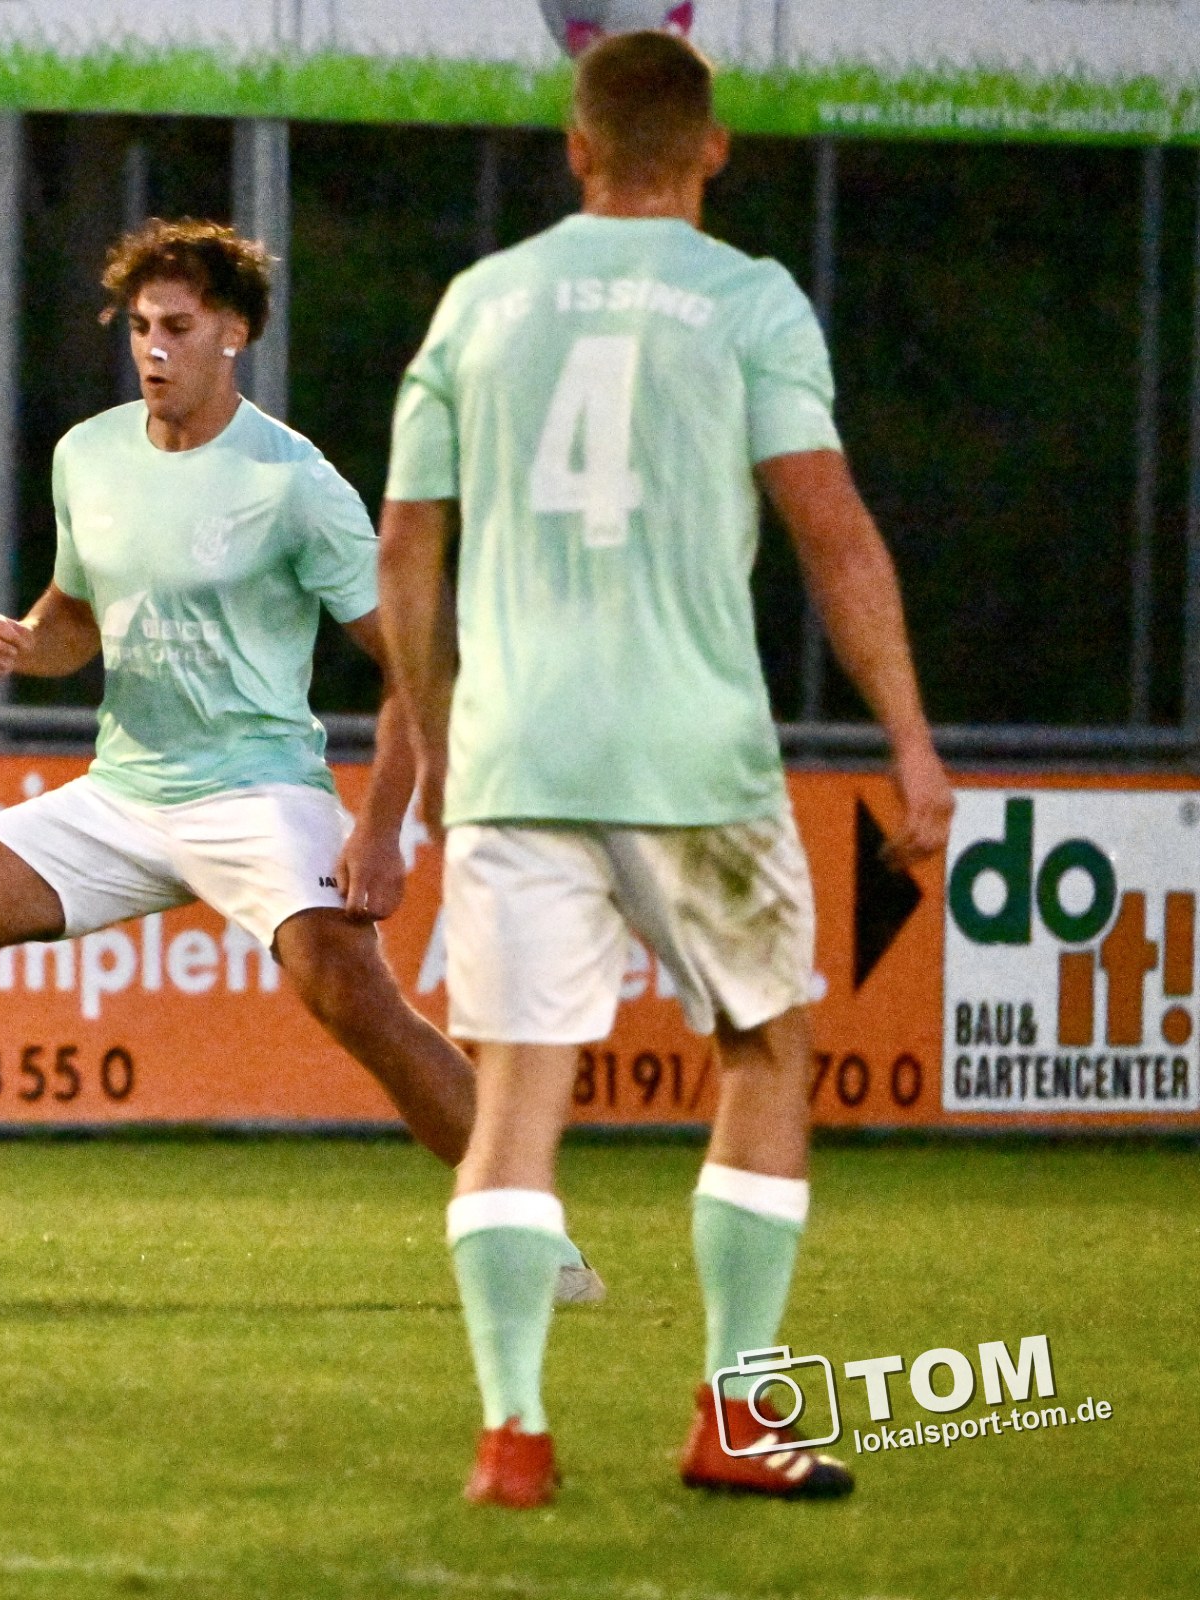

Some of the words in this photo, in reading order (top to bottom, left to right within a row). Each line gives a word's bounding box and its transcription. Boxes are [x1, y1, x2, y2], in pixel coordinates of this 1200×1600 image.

[555, 277, 714, 329] ISSING
[529, 334, 644, 549] 4
[950, 797, 1118, 945] do
[955, 1001, 1037, 1047] BAU&
[954, 1053, 1190, 1101] GARTENCENTER
